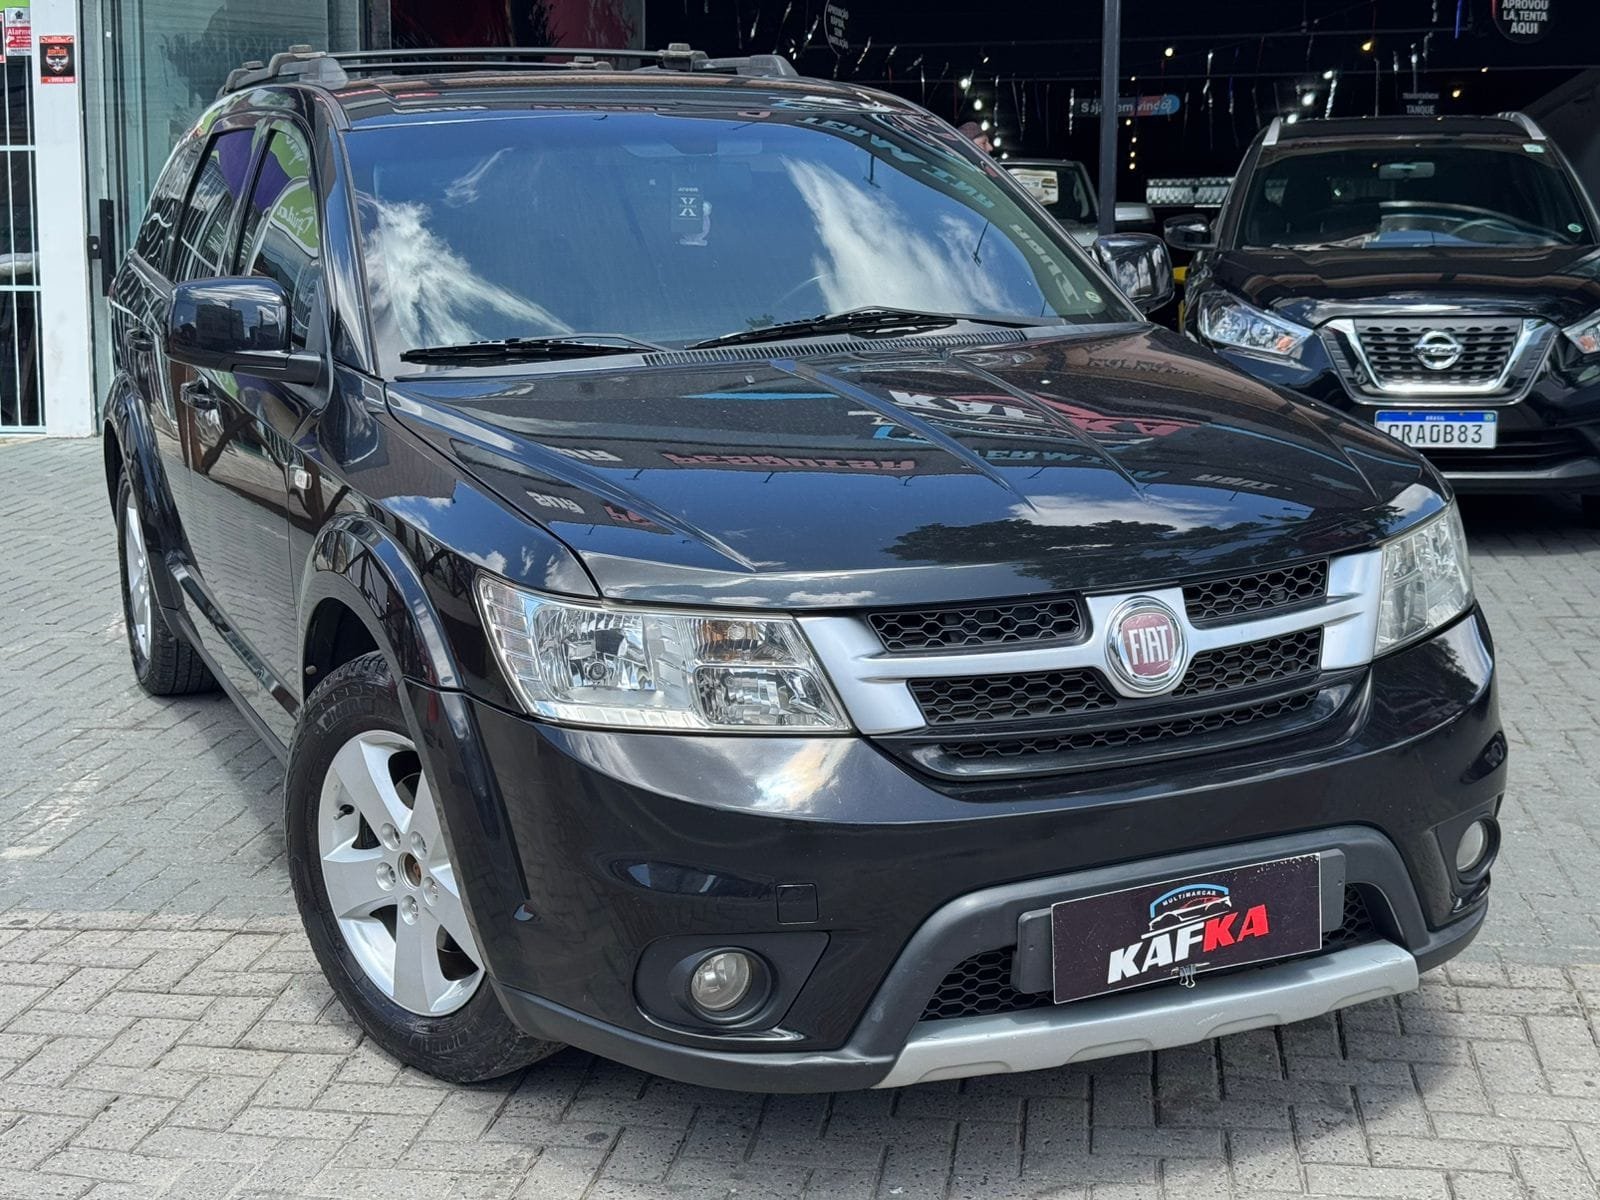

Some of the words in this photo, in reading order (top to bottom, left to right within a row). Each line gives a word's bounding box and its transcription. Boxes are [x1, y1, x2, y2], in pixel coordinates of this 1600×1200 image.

[1502, 0, 1549, 9] APROVOU
[1519, 11, 1548, 21] TENTA
[1510, 22, 1539, 34] AQUI
[1406, 105, 1435, 116] TANQUE
[1128, 625, 1169, 666] FIAT
[1107, 904, 1269, 984] KAFKA
